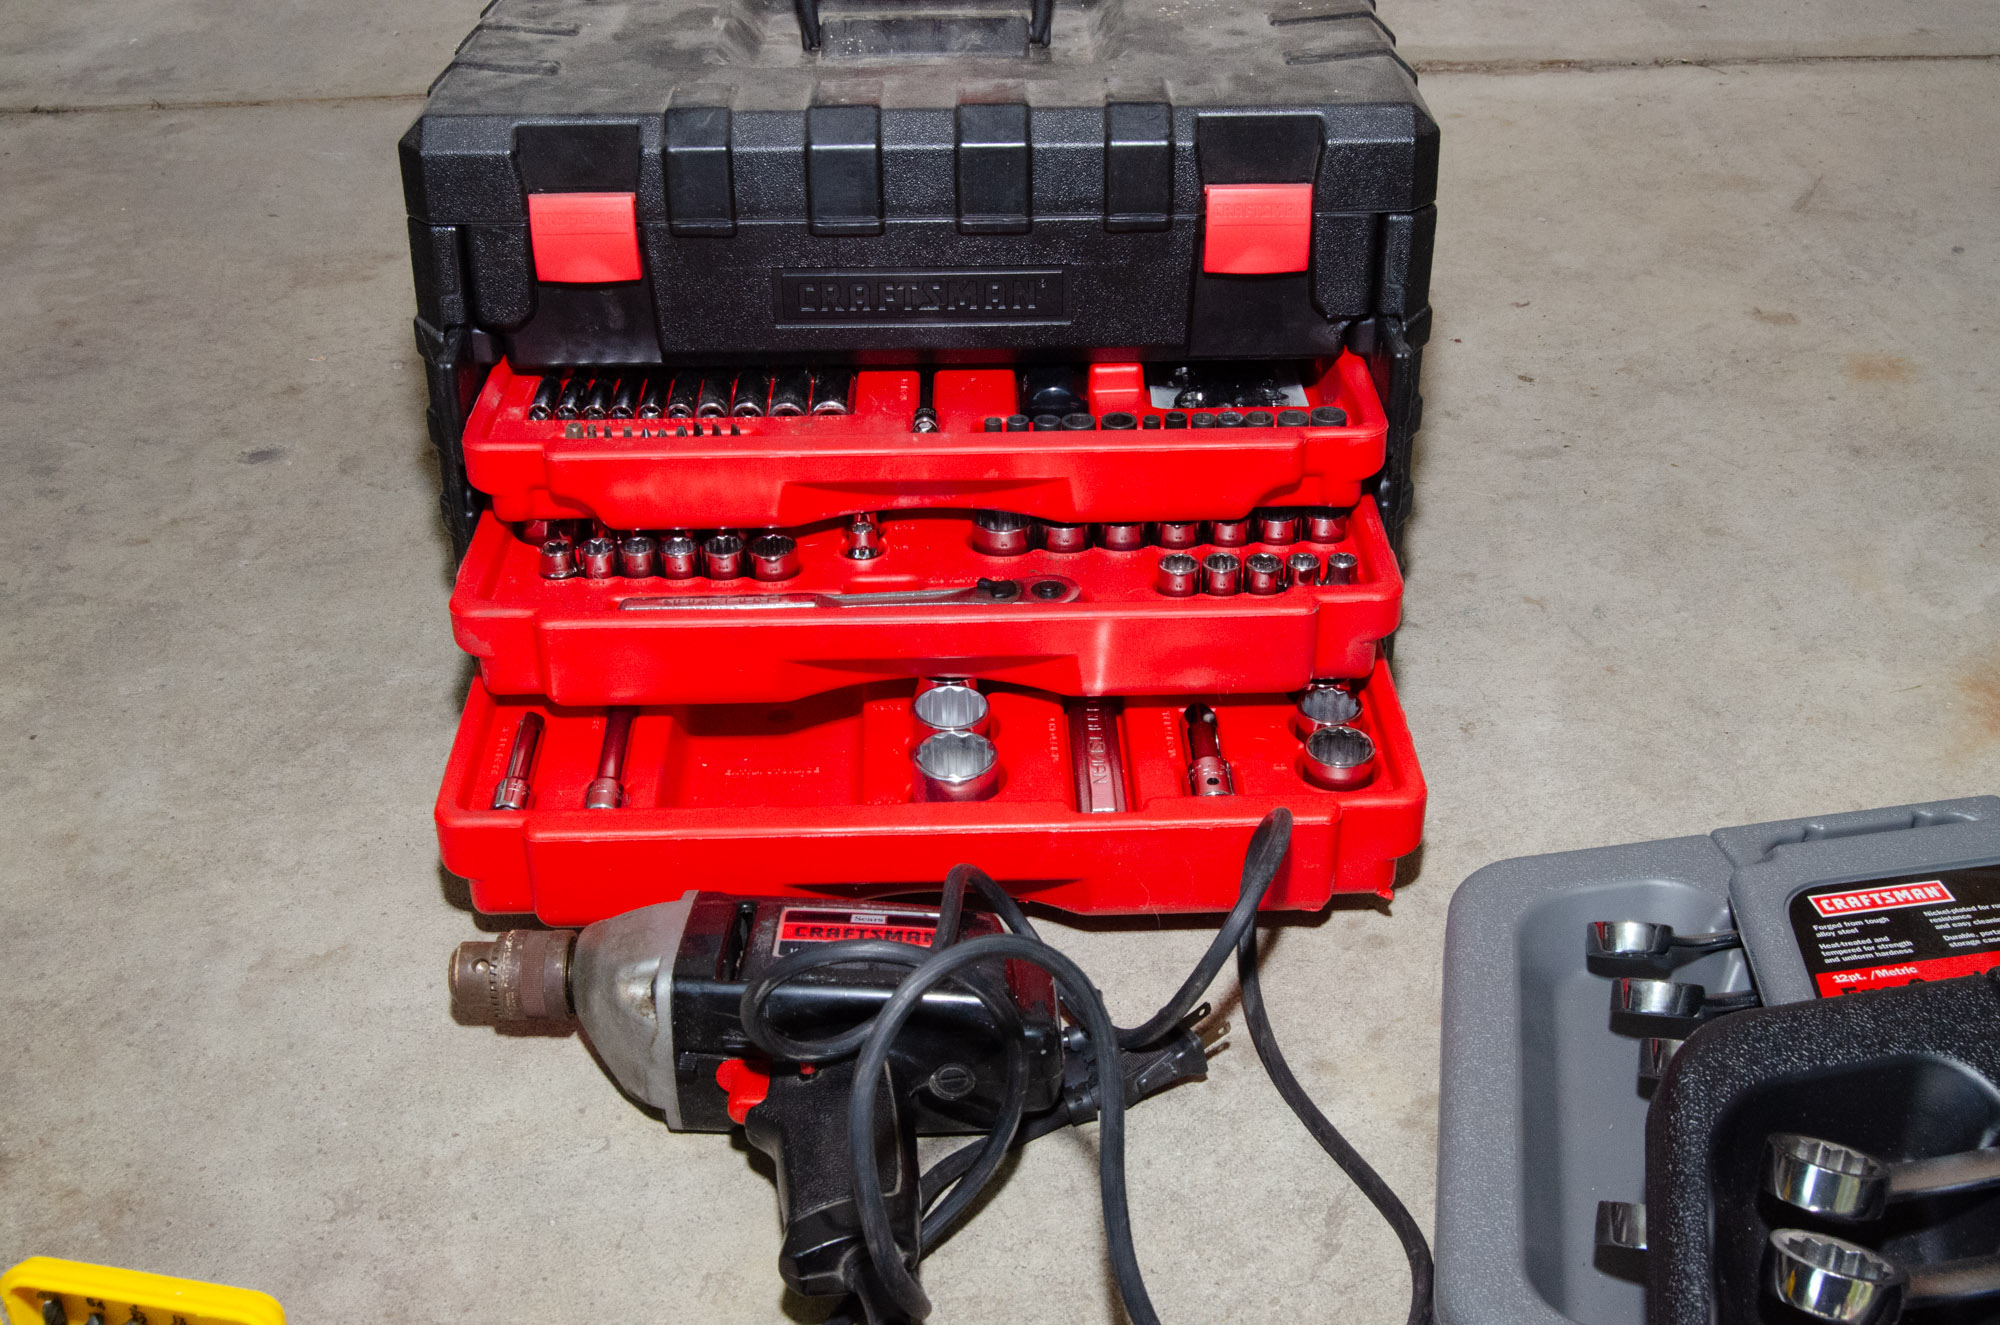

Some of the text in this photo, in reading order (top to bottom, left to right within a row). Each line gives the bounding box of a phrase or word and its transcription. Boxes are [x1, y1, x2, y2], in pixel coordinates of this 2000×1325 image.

[800, 279, 1038, 312] CRAFTSMAN
[1819, 886, 1942, 912] CRAFTSMAN
[1923, 906, 1977, 917] Nickel-plated
[854, 914, 884, 924] Sears
[1812, 916, 1890, 931] Forged from tough
[1929, 914, 1973, 924] resistance
[1952, 920, 1972, 928] easy
[794, 926, 935, 945] CRAFTSMAN
[1815, 927, 1859, 938] alloy steel
[1818, 938, 1873, 950] Heat-treated
[1821, 940, 1913, 957] tempered for strength
[1948, 939, 1982, 948] storage
[1824, 948, 1914, 964] and uniform hardness
[1832, 965, 1918, 984] 12pt. /Metric
